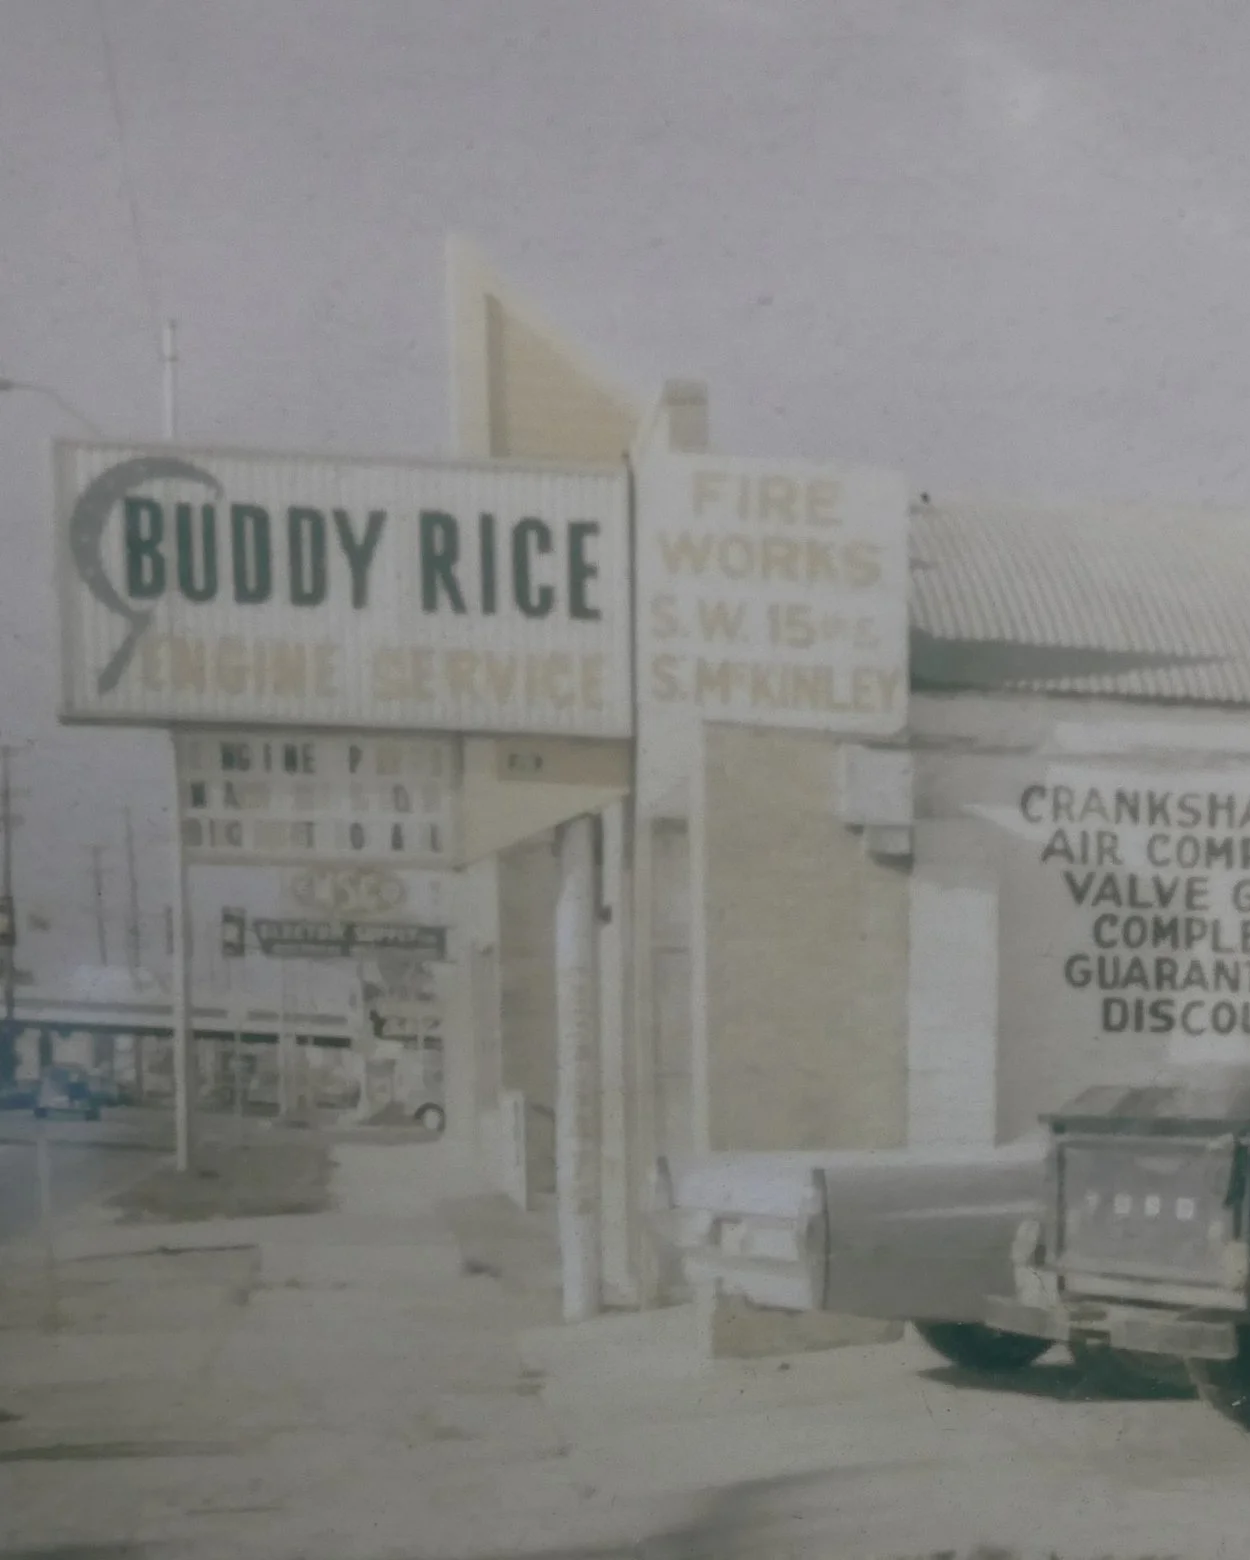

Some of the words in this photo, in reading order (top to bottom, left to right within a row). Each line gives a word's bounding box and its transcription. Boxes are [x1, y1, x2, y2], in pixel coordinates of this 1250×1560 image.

[692, 471, 841, 526] FIRE
[122, 496, 387, 610] BUDDY
[418, 508, 602, 622] RICE
[657, 531, 884, 588] WORKS
[138, 634, 338, 699] ENGINE
[371, 644, 605, 709] SERVICE
[1041, 828, 1125, 867] AIR
[1063, 870, 1210, 912] VALVE
